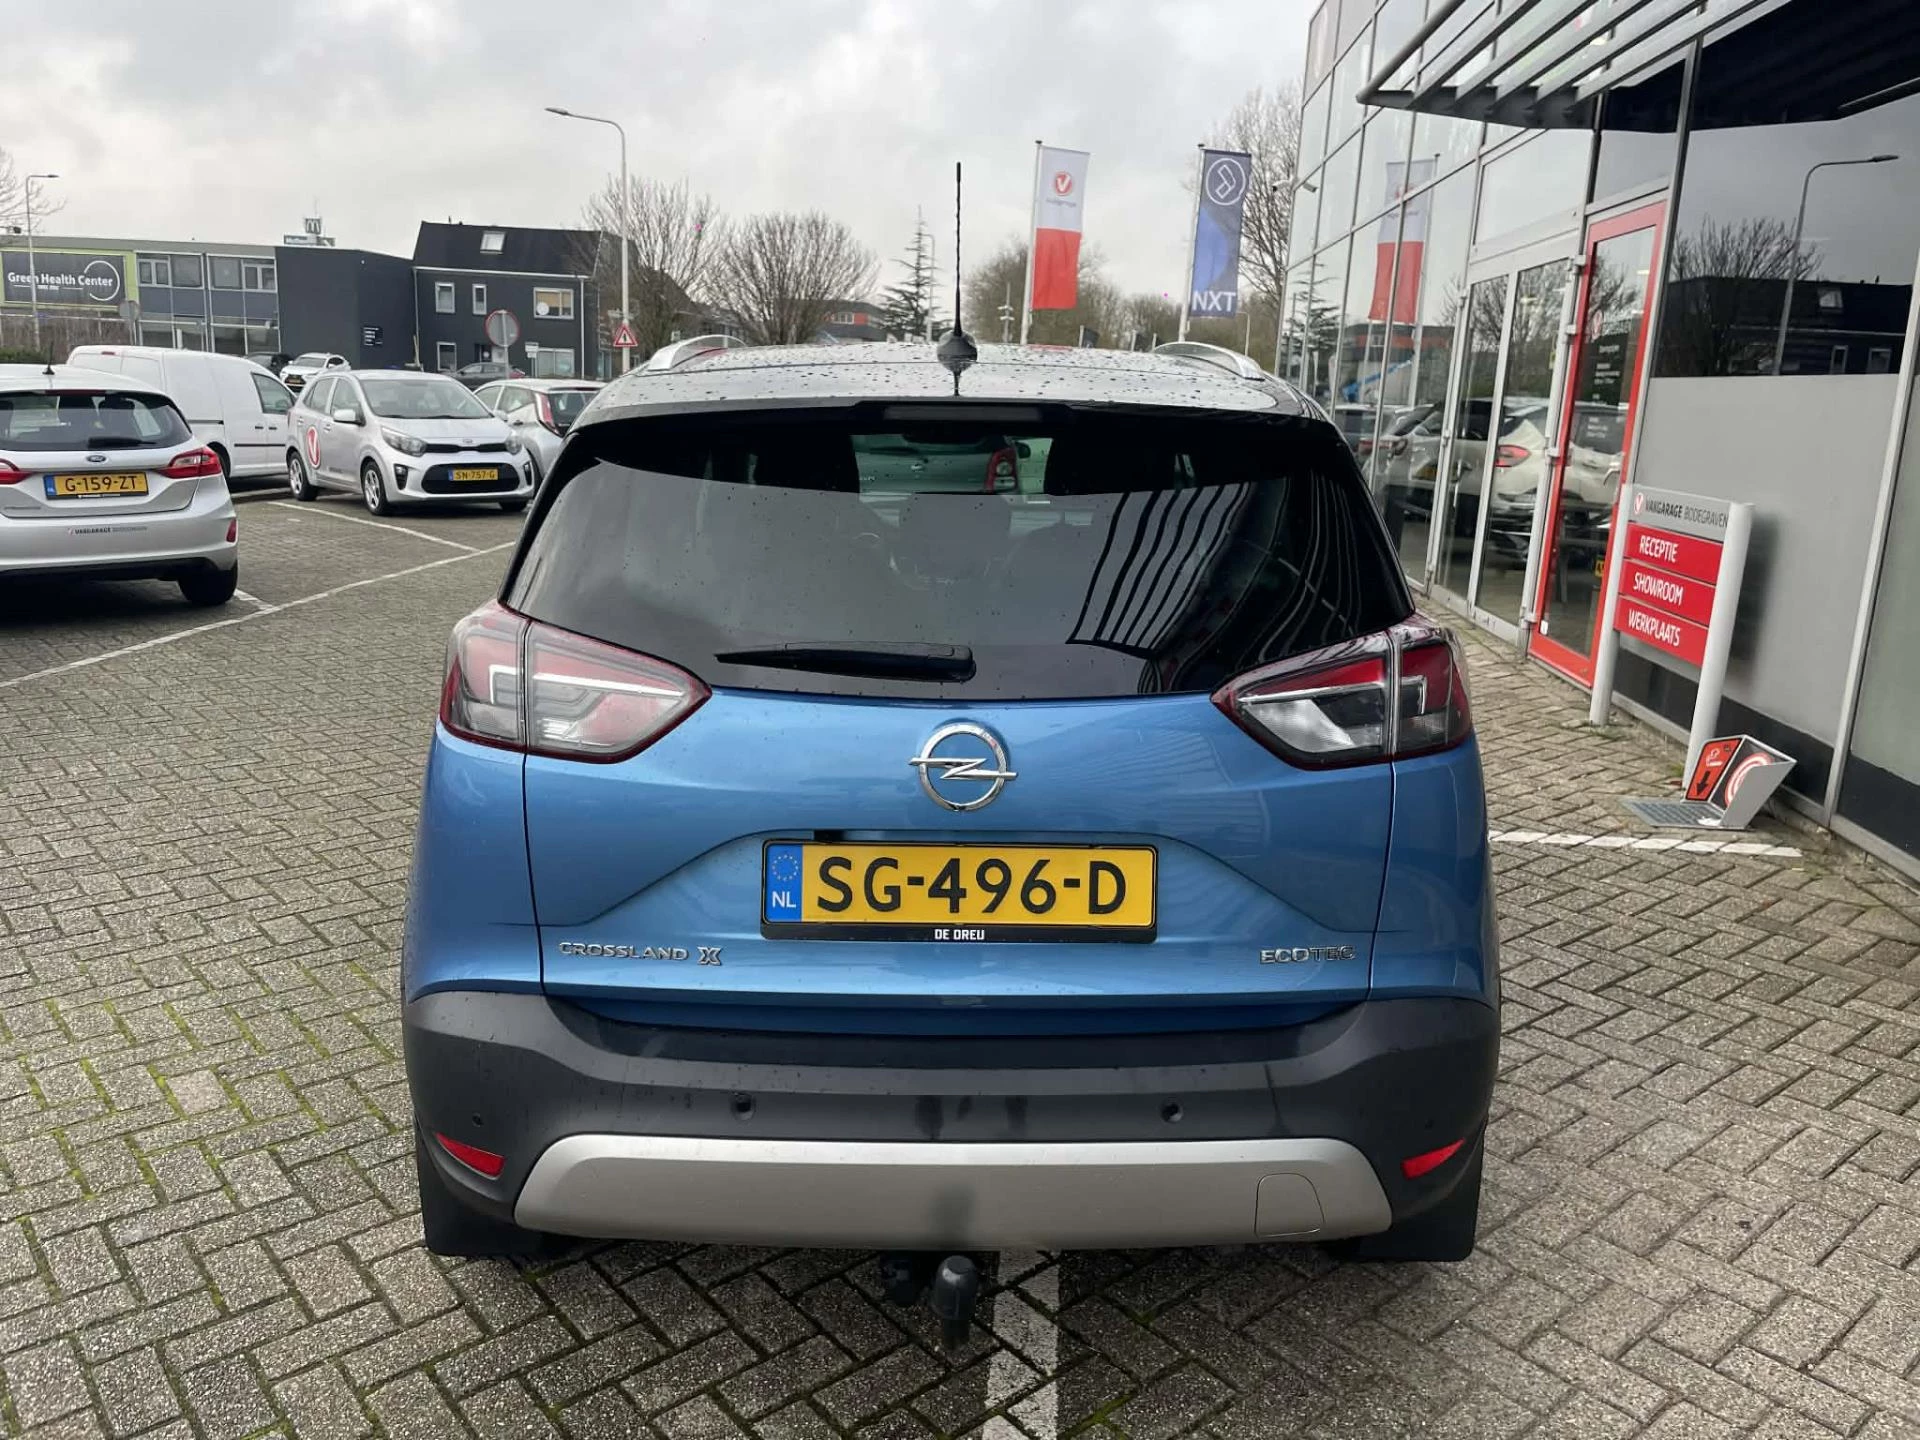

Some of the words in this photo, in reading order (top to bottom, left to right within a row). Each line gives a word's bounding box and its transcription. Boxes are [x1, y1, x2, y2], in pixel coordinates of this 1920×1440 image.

[8, 272, 39, 283] Green
[41, 273, 76, 286] Health
[78, 275, 113, 287] Center
[1193, 290, 1236, 312] NXT
[65, 475, 137, 492] G-159-ZT
[1639, 535, 1679, 563] RECEPTIE
[1633, 572, 1684, 606] SHOWROOM
[1628, 609, 1680, 647] WERKPLAATS
[771, 890, 797, 909] NL
[816, 856, 1127, 915] SG-496-D
[935, 928, 950, 940] DE
[953, 929, 985, 941] DREU
[559, 942, 689, 961] CROSSLAND
[697, 946, 723, 966] X
[1260, 945, 1356, 964] ECOTEC
